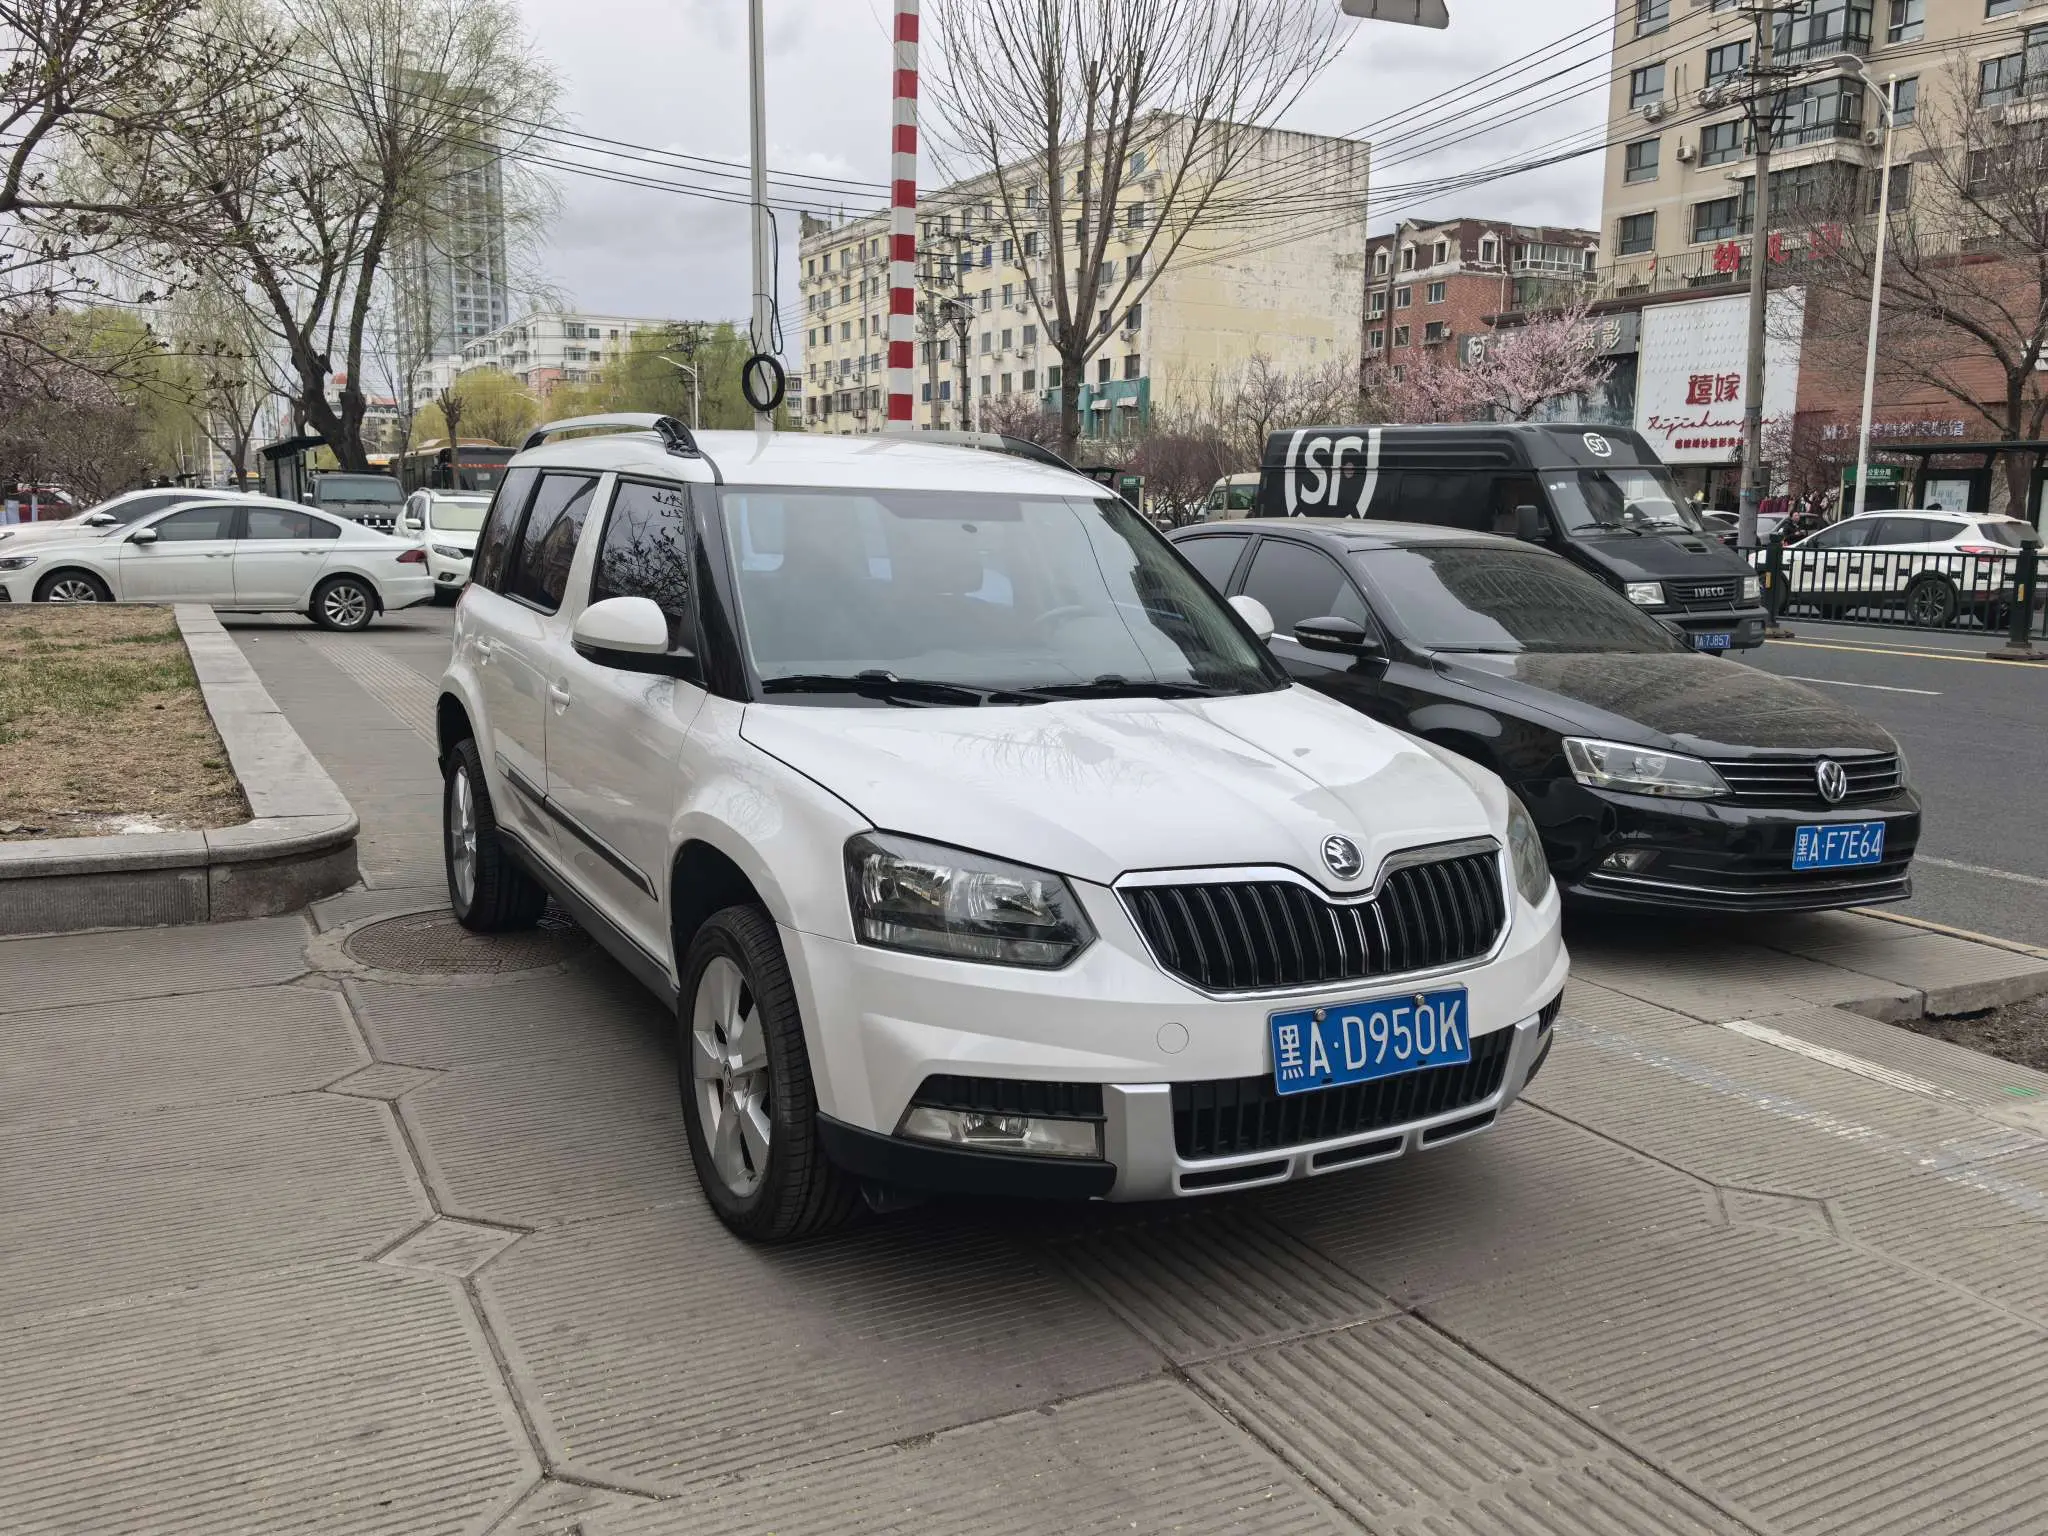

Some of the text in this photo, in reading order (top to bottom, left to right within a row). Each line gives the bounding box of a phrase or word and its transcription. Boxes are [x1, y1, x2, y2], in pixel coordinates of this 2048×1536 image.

[1694, 586, 1725, 598] IVECO
[1796, 829, 1882, 863] 黑A·F7E64
[1278, 1000, 1465, 1081] 黑A·D950K
